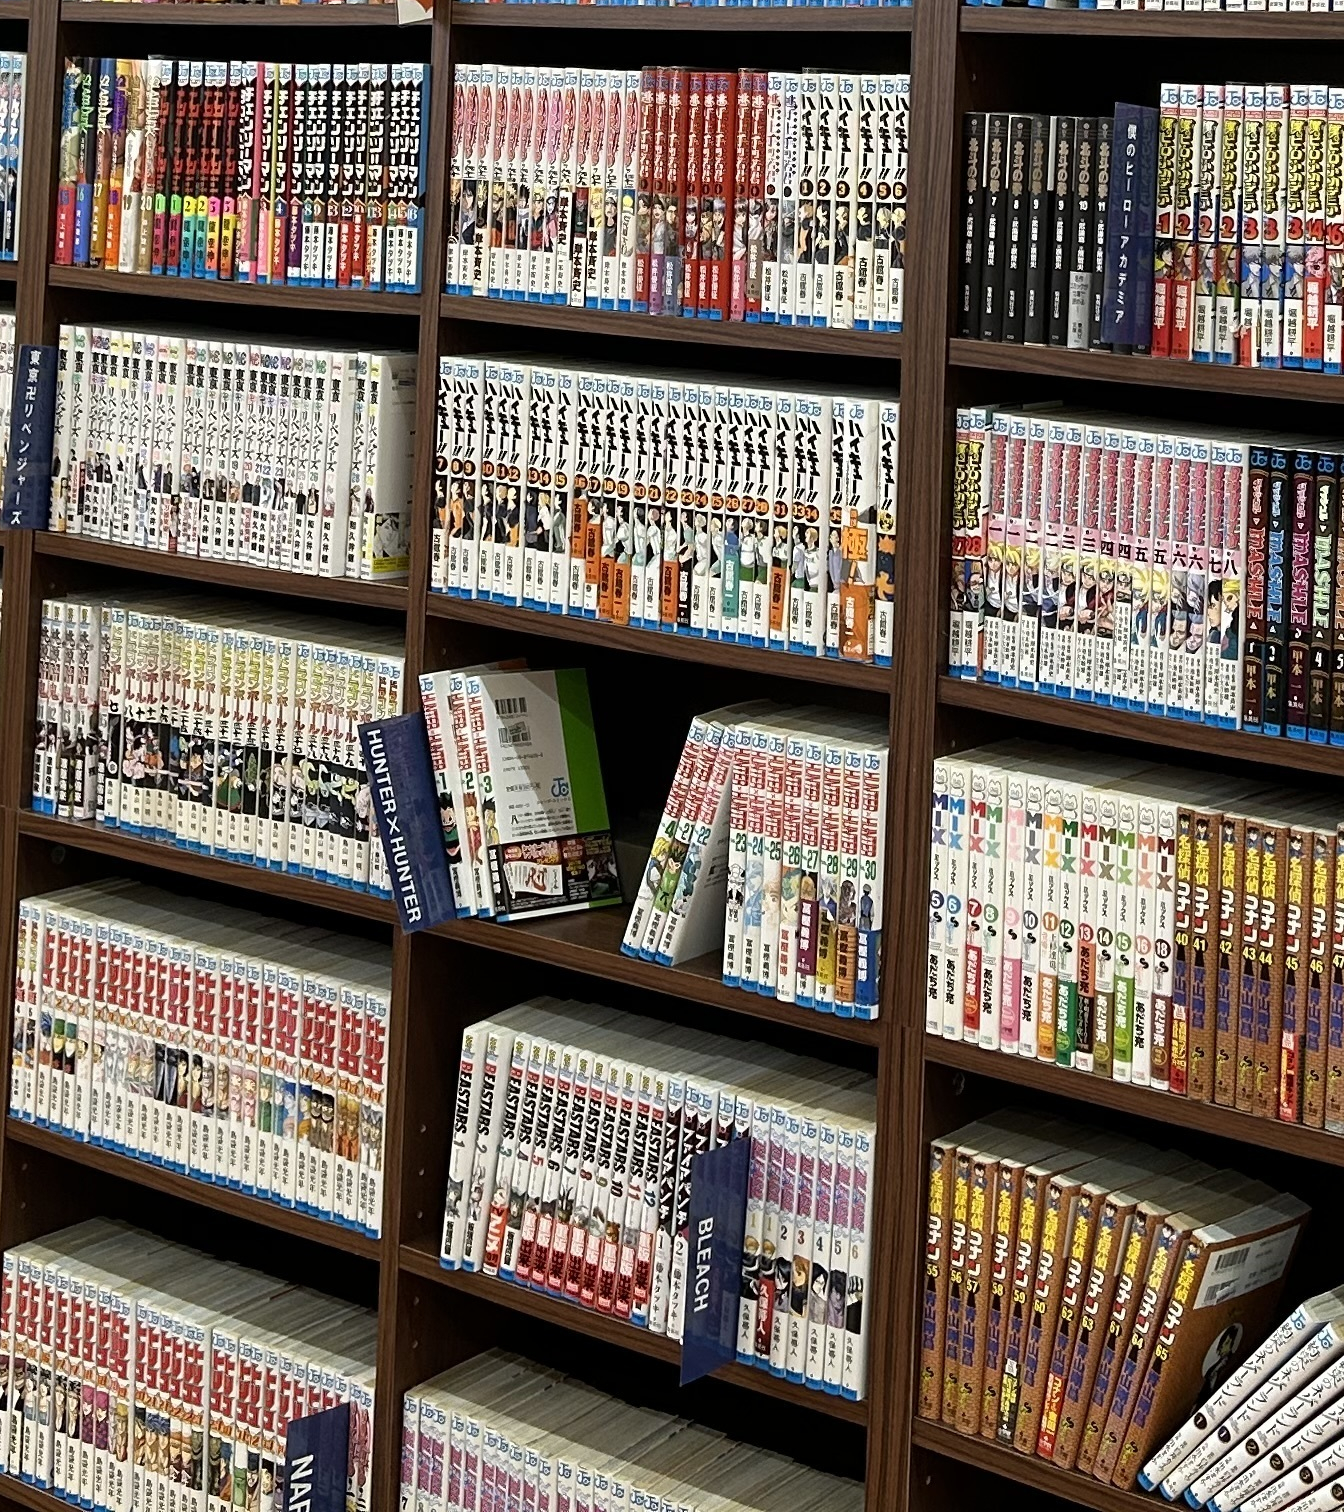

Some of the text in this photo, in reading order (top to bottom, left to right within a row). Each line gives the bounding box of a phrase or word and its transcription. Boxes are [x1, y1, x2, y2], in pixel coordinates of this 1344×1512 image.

[1115, 124, 1138, 324] 僕のヒーローアカデミア
[10, 350, 41, 525] 東京卍リベンジャーズ
[948, 797, 965, 850] MIX
[969, 802, 986, 854] MIX
[1063, 821, 1077, 873] MIX
[1099, 826, 1116, 880] MIX
[1157, 838, 1174, 892] MIX
[1219, 942, 1232, 954] 42
[1285, 958, 1299, 970] 45
[478, 1064, 496, 1136] BEASTARS
[535, 1075, 555, 1149] BEASTARS
[599, 1091, 617, 1169] BEASTARS
[644, 1106, 664, 1184] BEASTARS
[694, 1217, 713, 1313] BLEACH
[926, 1264, 938, 1278] 55
[1034, 1302, 1046, 1314] 60
[1156, 1344, 1168, 1360] 65
